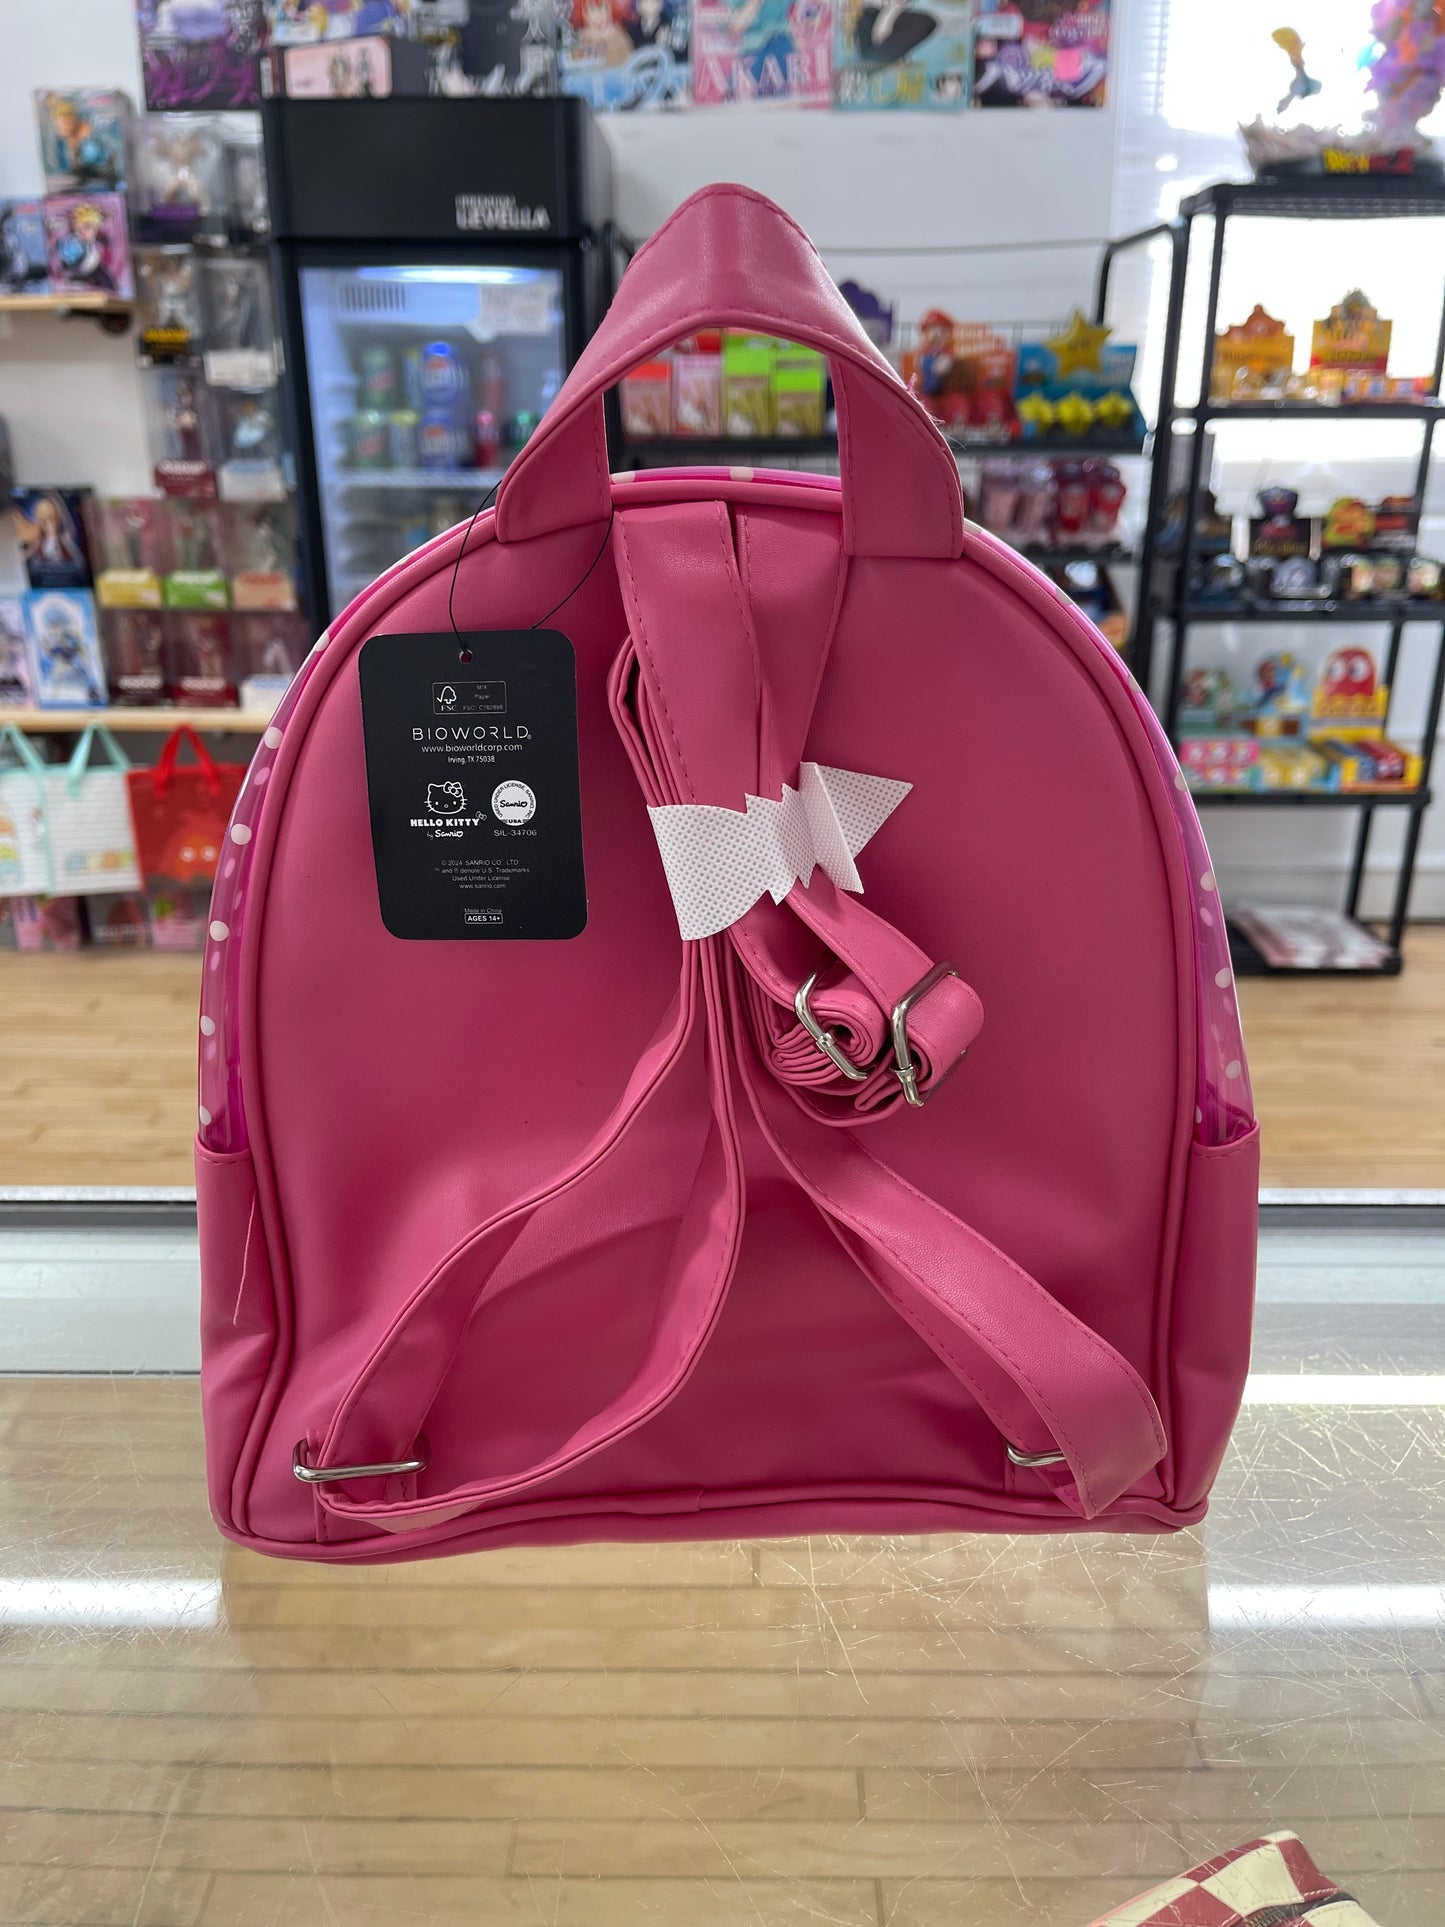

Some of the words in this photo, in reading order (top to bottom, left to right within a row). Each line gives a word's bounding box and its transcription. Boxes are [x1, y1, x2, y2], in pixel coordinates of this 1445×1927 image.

[421, 743, 523, 753] www.bioworldcorp.com
[448, 756, 466, 765] Irving,
[467, 755, 474, 763] TX
[476, 755, 496, 763] 75038
[499, 799, 528, 808] Sanrio
[410, 818, 443, 827] HELLO
[446, 818, 480, 827] KITTY
[435, 829, 463, 838] Sanrio
[493, 829, 538, 837] SIL-34706
